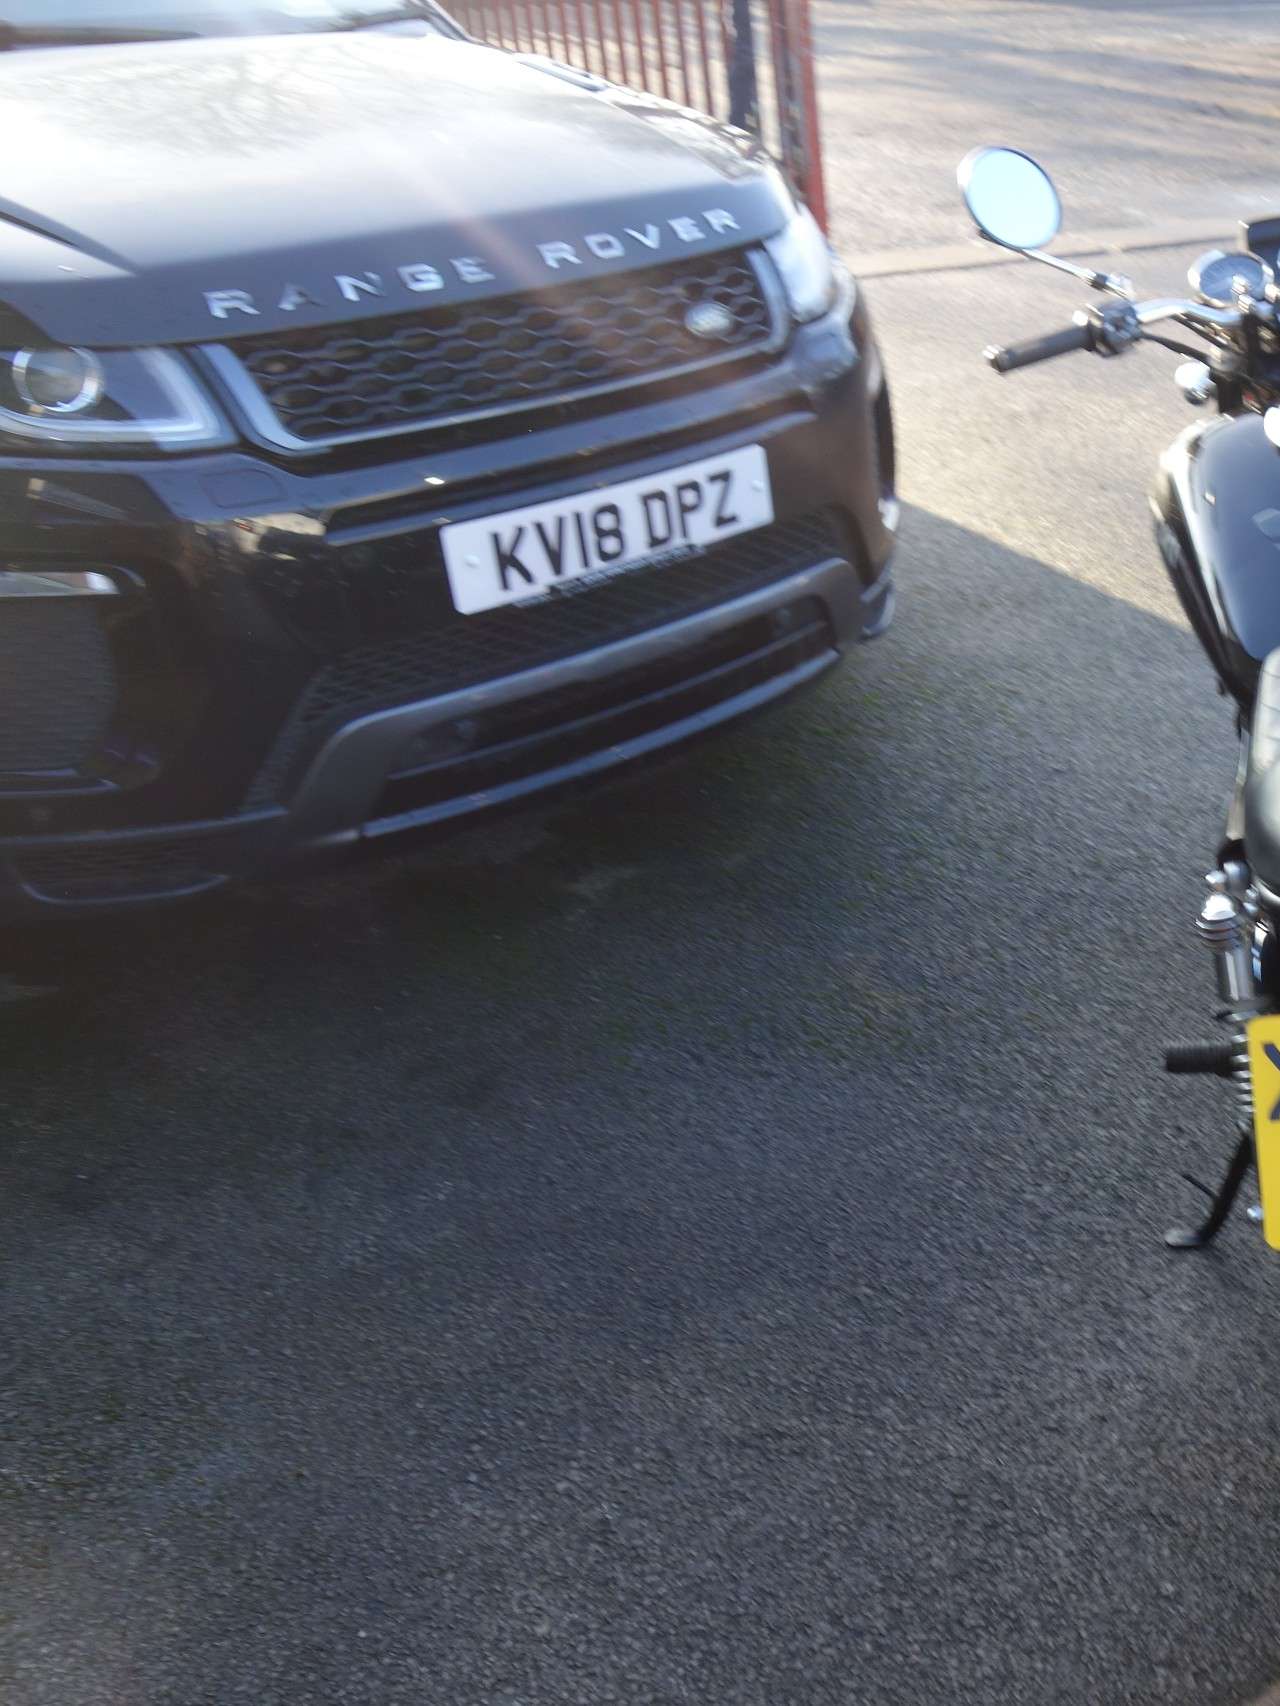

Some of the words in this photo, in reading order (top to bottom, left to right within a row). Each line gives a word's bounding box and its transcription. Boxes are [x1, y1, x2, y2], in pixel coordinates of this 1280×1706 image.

[203, 255, 496, 319] RANGE
[536, 207, 742, 269] ROVER
[488, 503, 626, 591] KV18
[642, 470, 739, 549] DPZ
